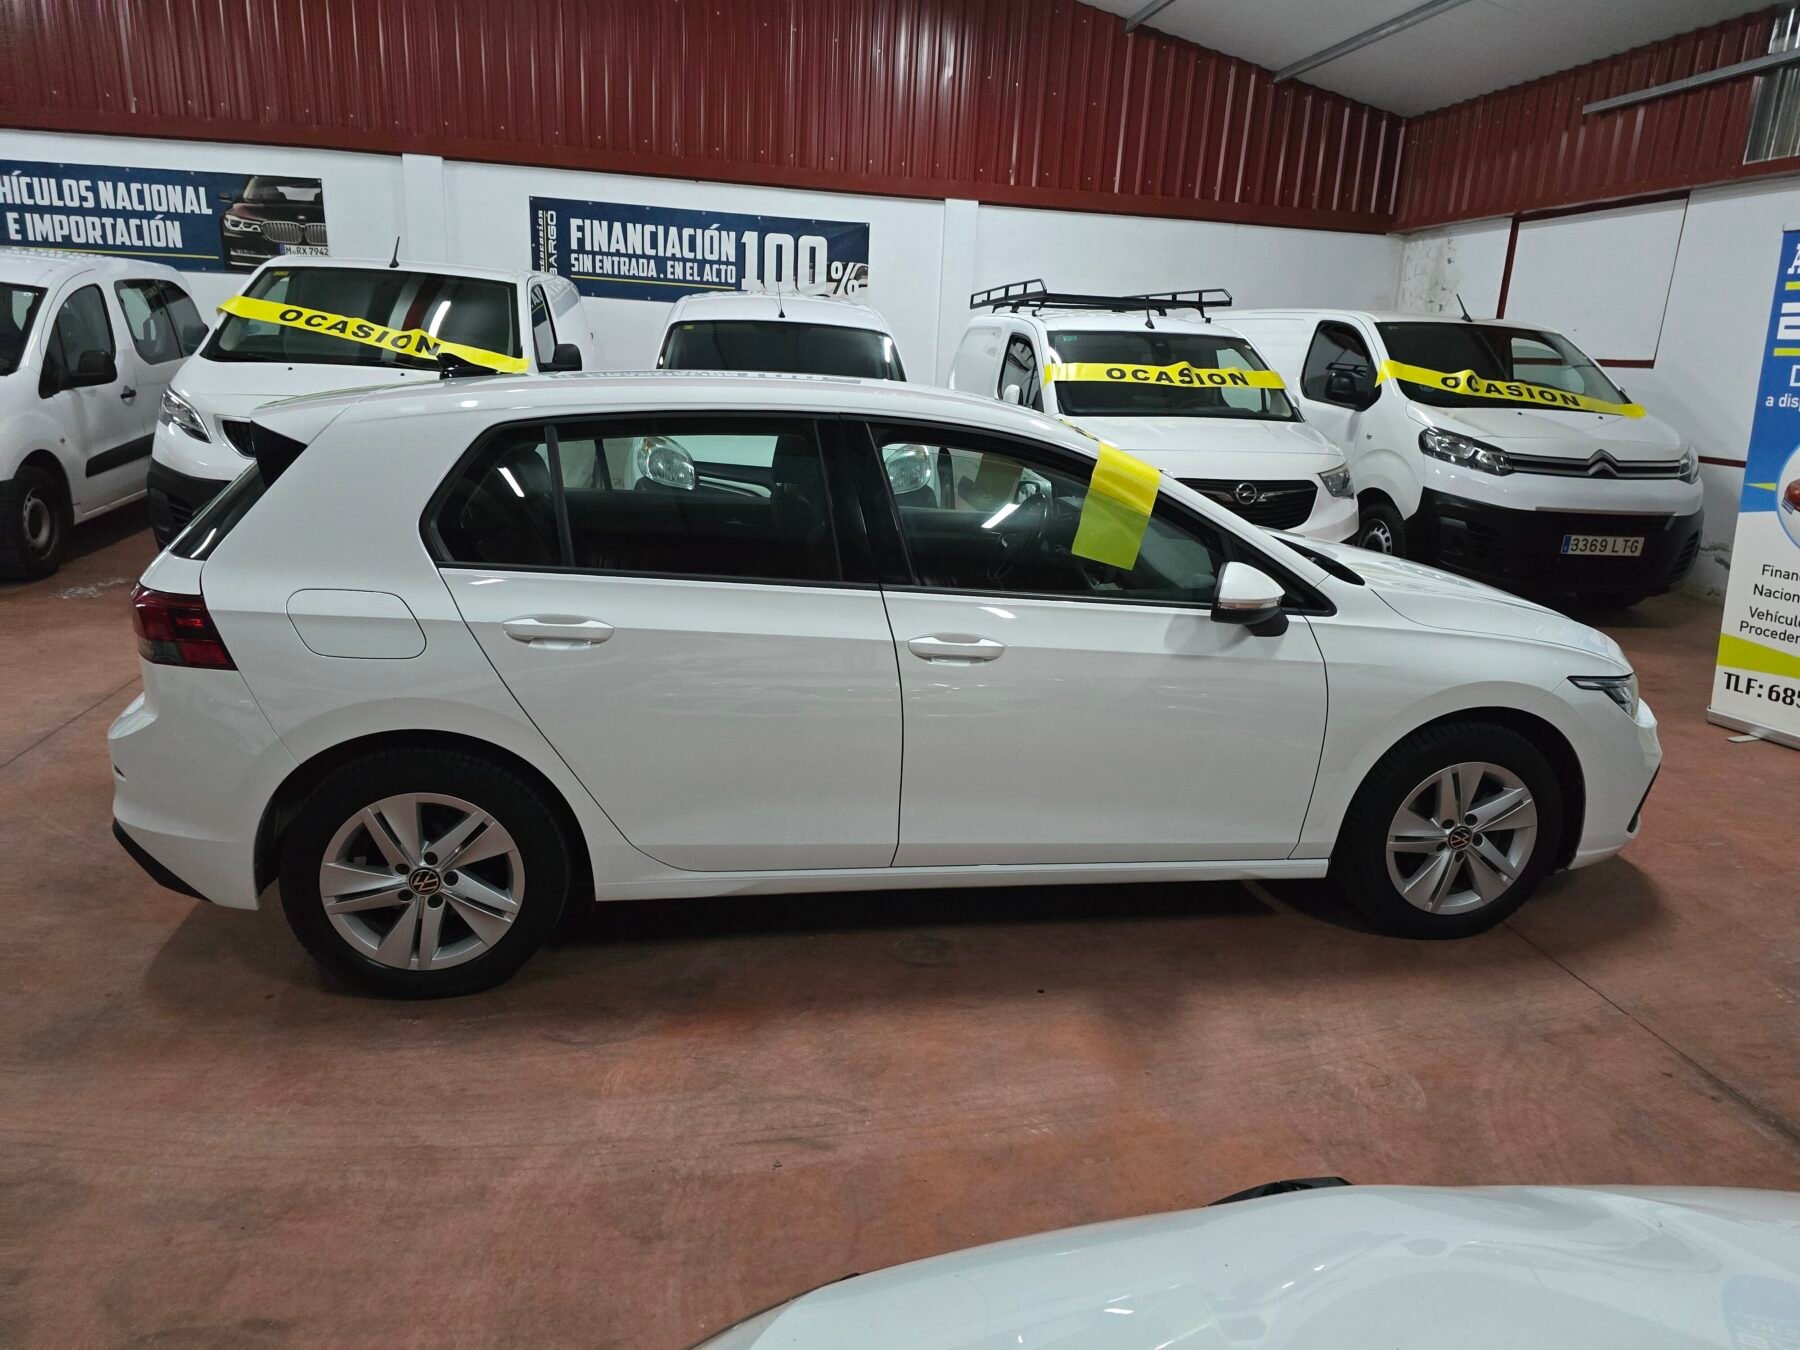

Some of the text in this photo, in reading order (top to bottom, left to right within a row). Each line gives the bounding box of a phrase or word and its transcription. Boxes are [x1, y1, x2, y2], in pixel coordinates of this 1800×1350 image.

[97, 180, 213, 214] NACIONAL
[5, 211, 183, 248] E IMPORTACIÓN
[569, 218, 737, 263] FINANCIACIÓN
[570, 252, 593, 273] SIN
[666, 258, 684, 280] EN
[685, 260, 701, 282] EL
[703, 264, 737, 284] ACTO
[278, 309, 441, 356] OCASION
[1105, 367, 1250, 386] OCASION
[1440, 374, 1582, 407] OCASION
[1765, 393, 1800, 411] a dis
[1570, 537, 1640, 554] 3369 LTG
[1761, 563, 1800, 583] Finan
[1723, 671, 1765, 698] TLF:
